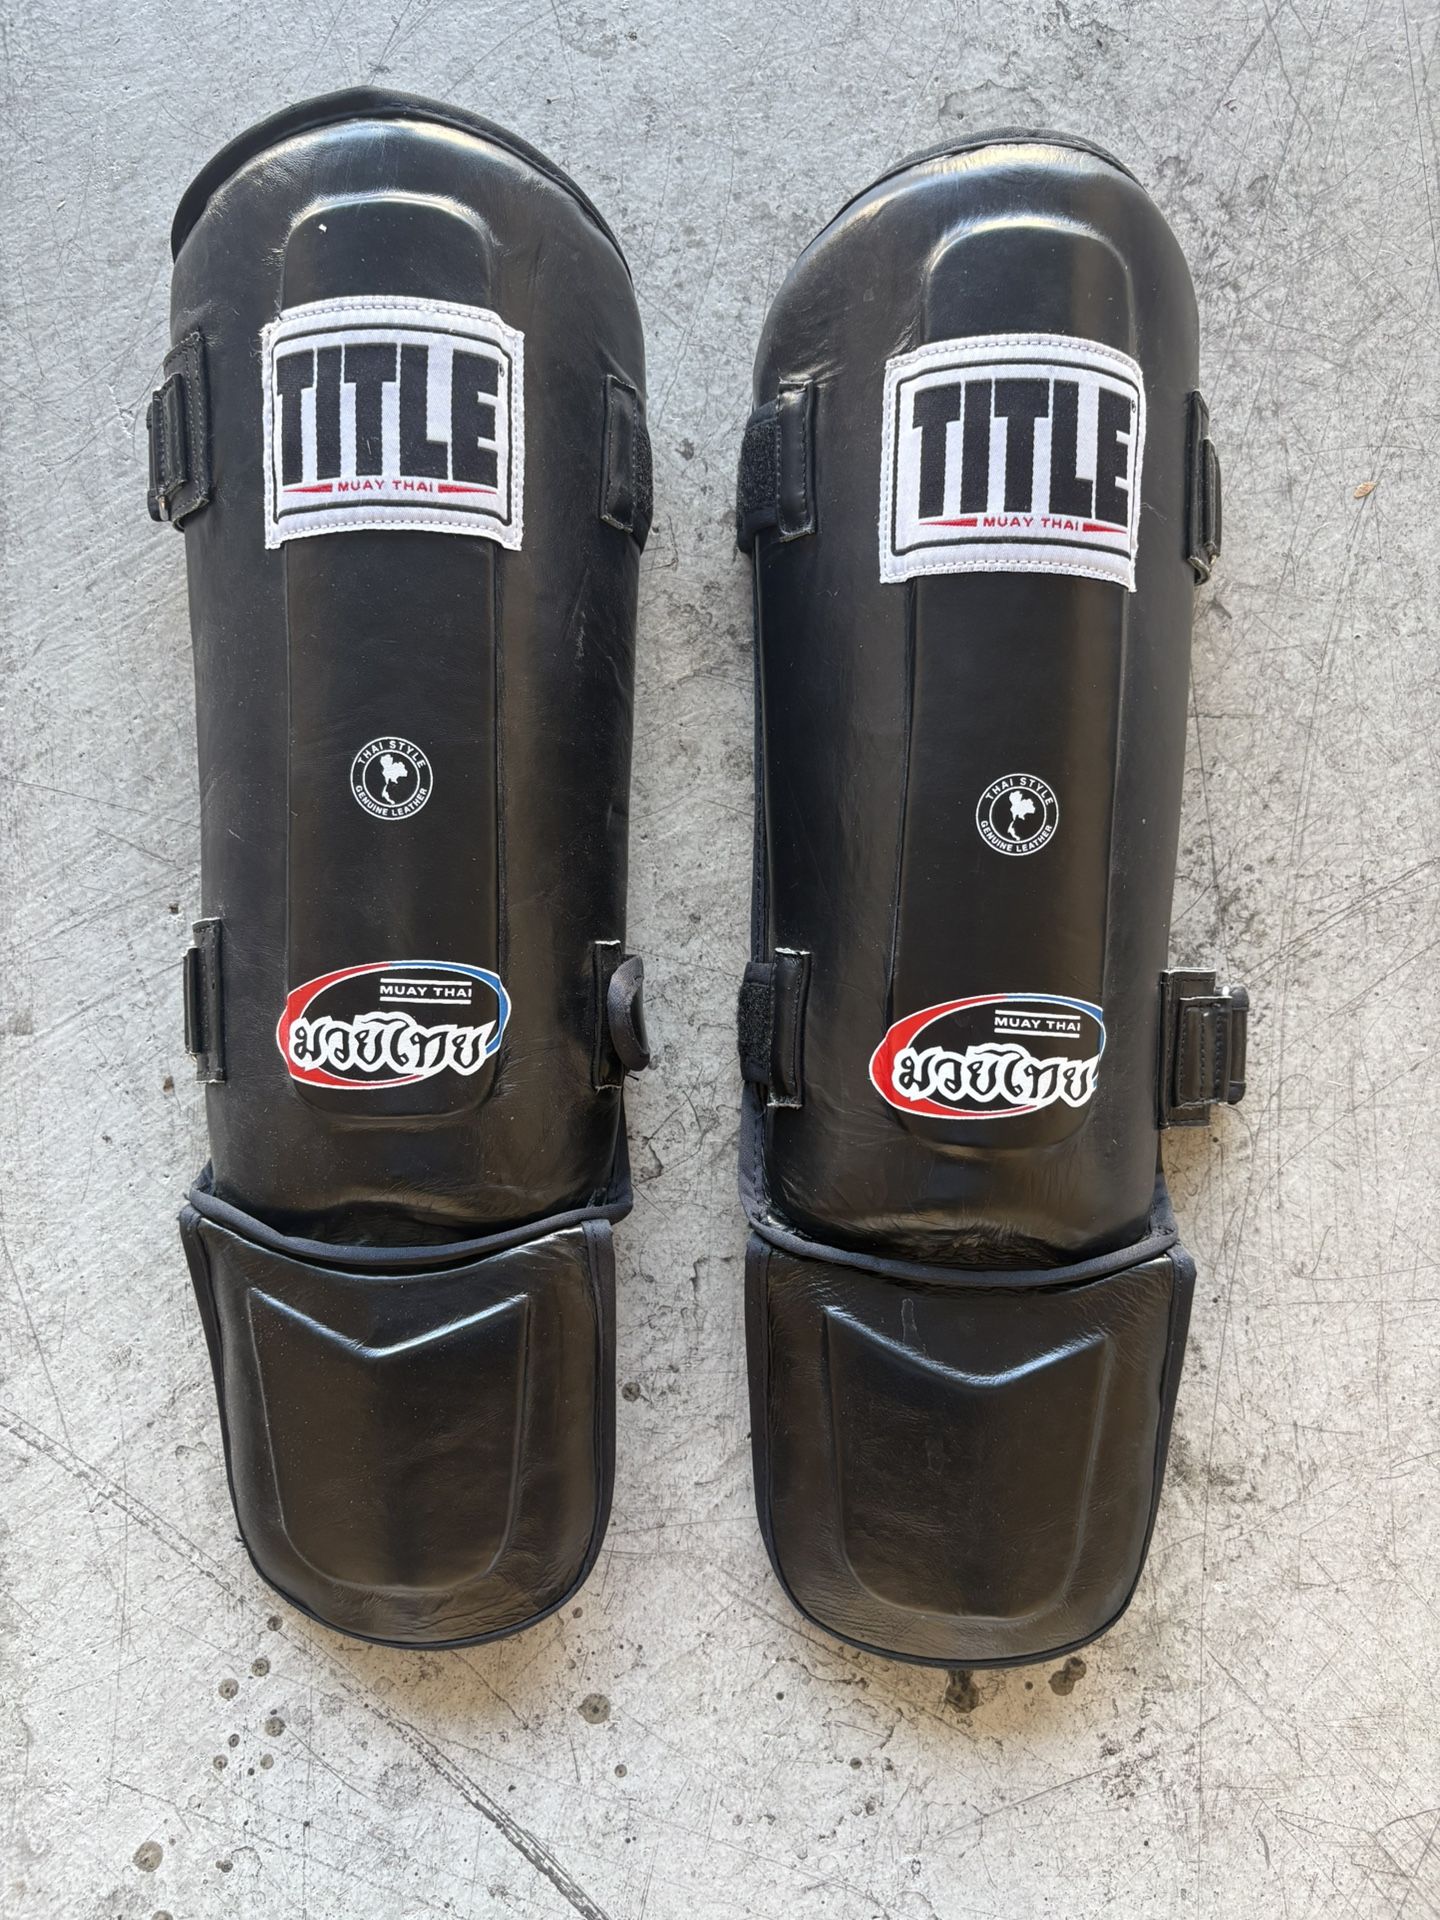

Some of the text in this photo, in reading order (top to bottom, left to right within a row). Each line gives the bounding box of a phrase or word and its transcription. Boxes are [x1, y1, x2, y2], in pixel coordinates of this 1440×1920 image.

[276, 342, 500, 489] TITLE
[912, 376, 1132, 528] TITLE
[337, 480, 433, 493] MUAY THAI
[982, 516, 1080, 532] MUAY THAI
[357, 740, 426, 769] THAI STYLE
[355, 785, 428, 817] GENUINE LEATHER
[985, 777, 1054, 806] THAI STYLE
[980, 820, 1053, 852] GENUINE LEATHER
[379, 985, 473, 998] MUAY THAI
[994, 1016, 1081, 1032] MUAY THAI
[291, 1014, 490, 1072] มวยไทย
[895, 1045, 1093, 1104] มวยไทย
